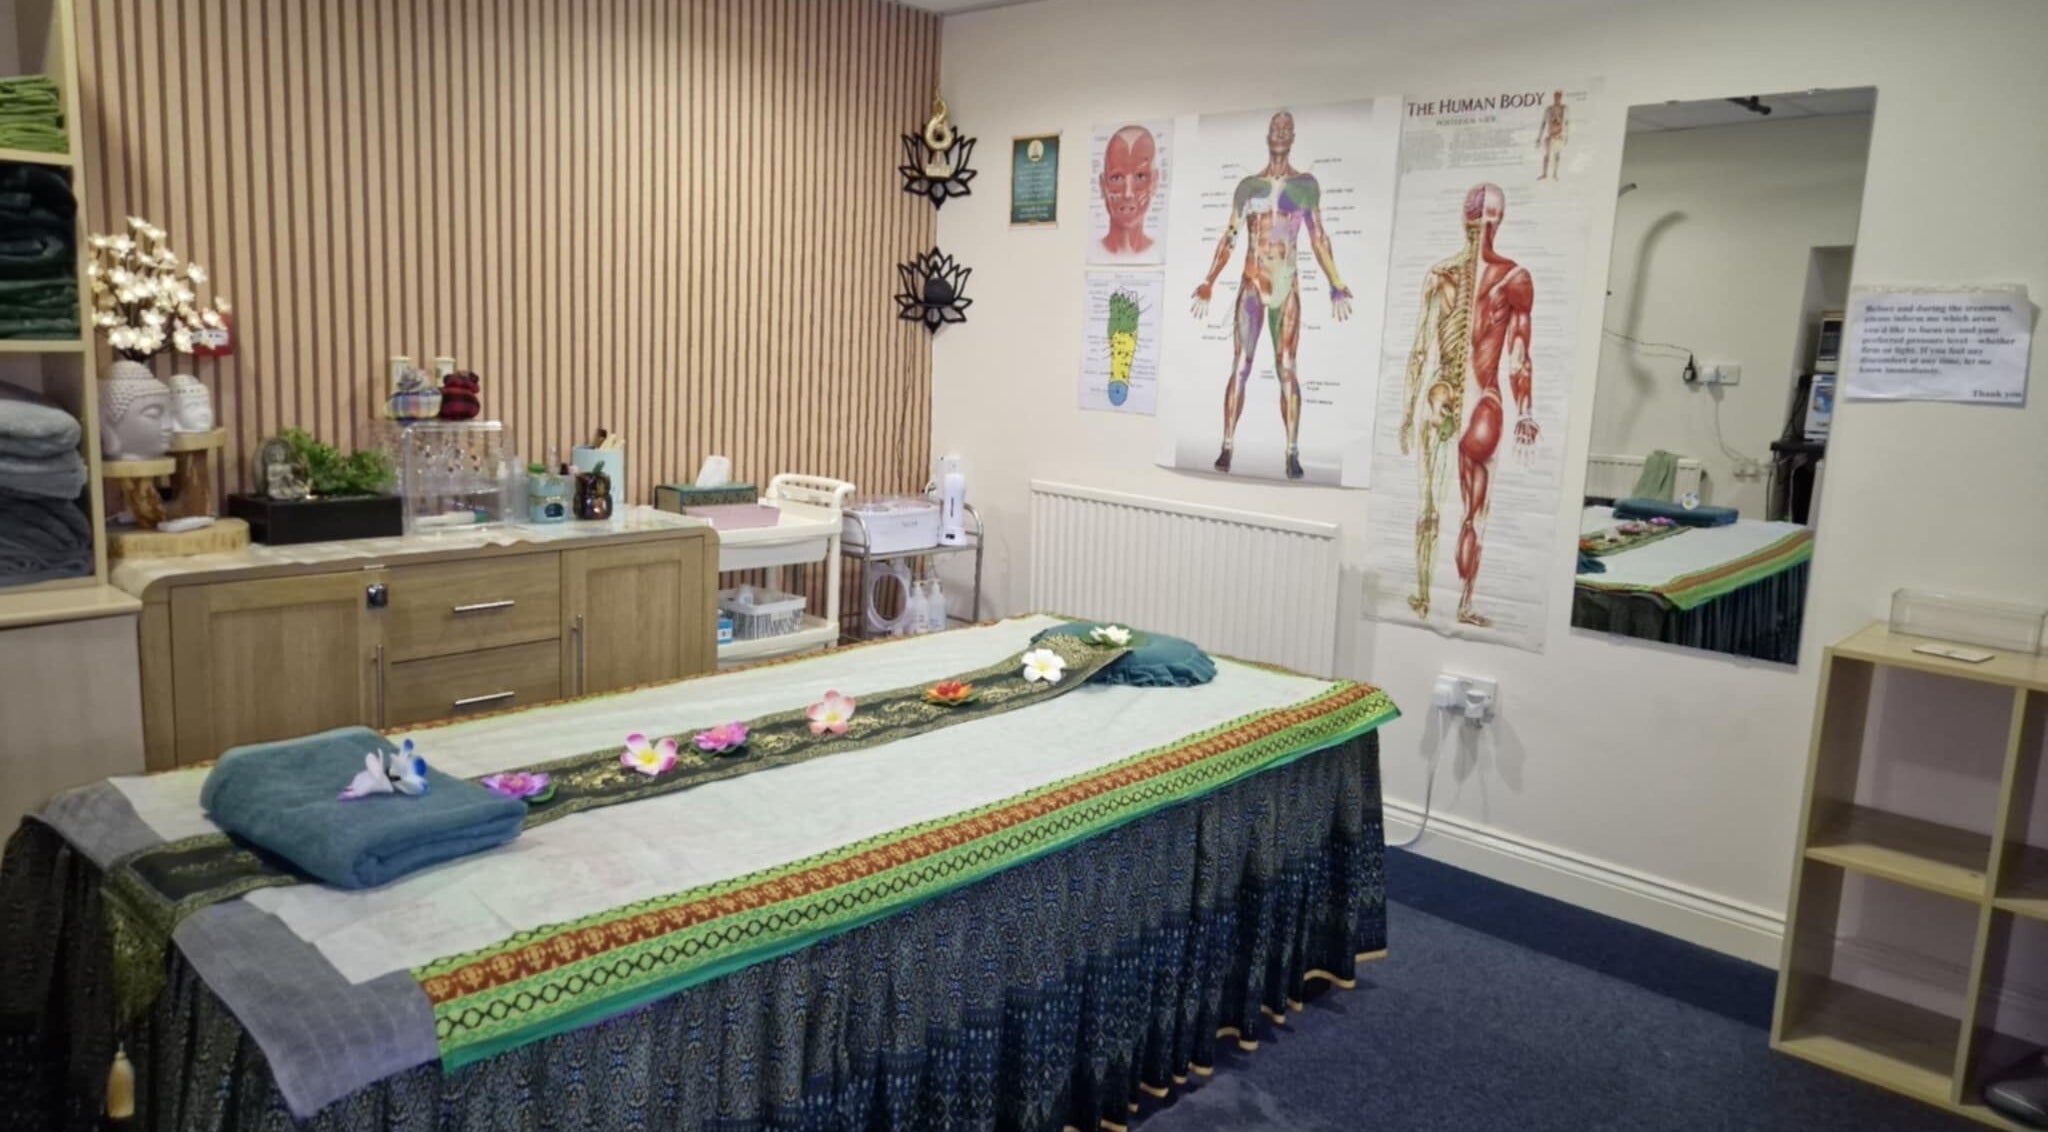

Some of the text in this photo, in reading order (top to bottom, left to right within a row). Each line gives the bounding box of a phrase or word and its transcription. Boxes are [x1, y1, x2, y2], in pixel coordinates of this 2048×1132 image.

[1408, 101, 1436, 117] THE
[1439, 96, 1496, 115] HUMAN
[1500, 91, 1546, 110] BODY
[1865, 305, 1895, 313] Before
[1897, 304, 1914, 313] and
[1916, 304, 1946, 314] during
[1948, 304, 1962, 312] the
[1893, 314, 1924, 322] inform
[1942, 314, 1969, 322] which
[1958, 326, 1976, 334] and
[1972, 389, 2002, 399] Thank
